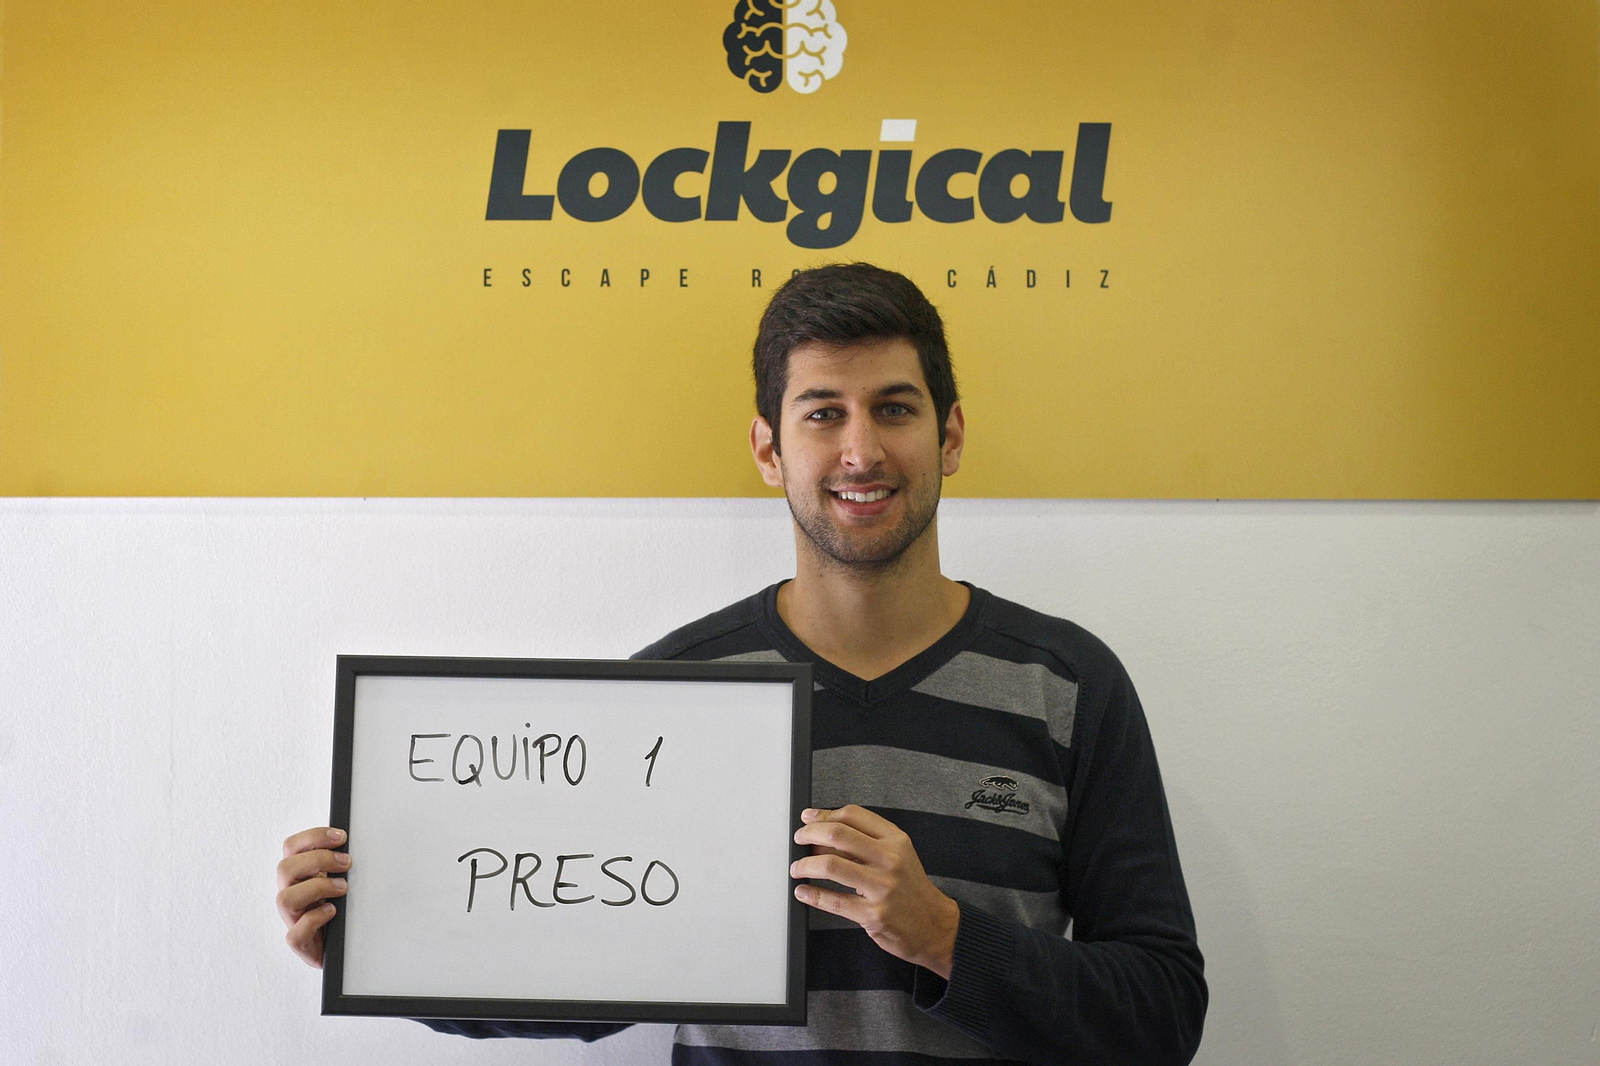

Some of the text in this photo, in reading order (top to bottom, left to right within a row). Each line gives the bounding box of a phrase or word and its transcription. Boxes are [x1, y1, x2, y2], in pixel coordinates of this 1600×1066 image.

[485, 119, 1113, 249] Lockgical
[483, 265, 1111, 289] ESCAPE CÁDIZ
[644, 736, 664, 787] 1
[458, 847, 680, 914] PRESO
